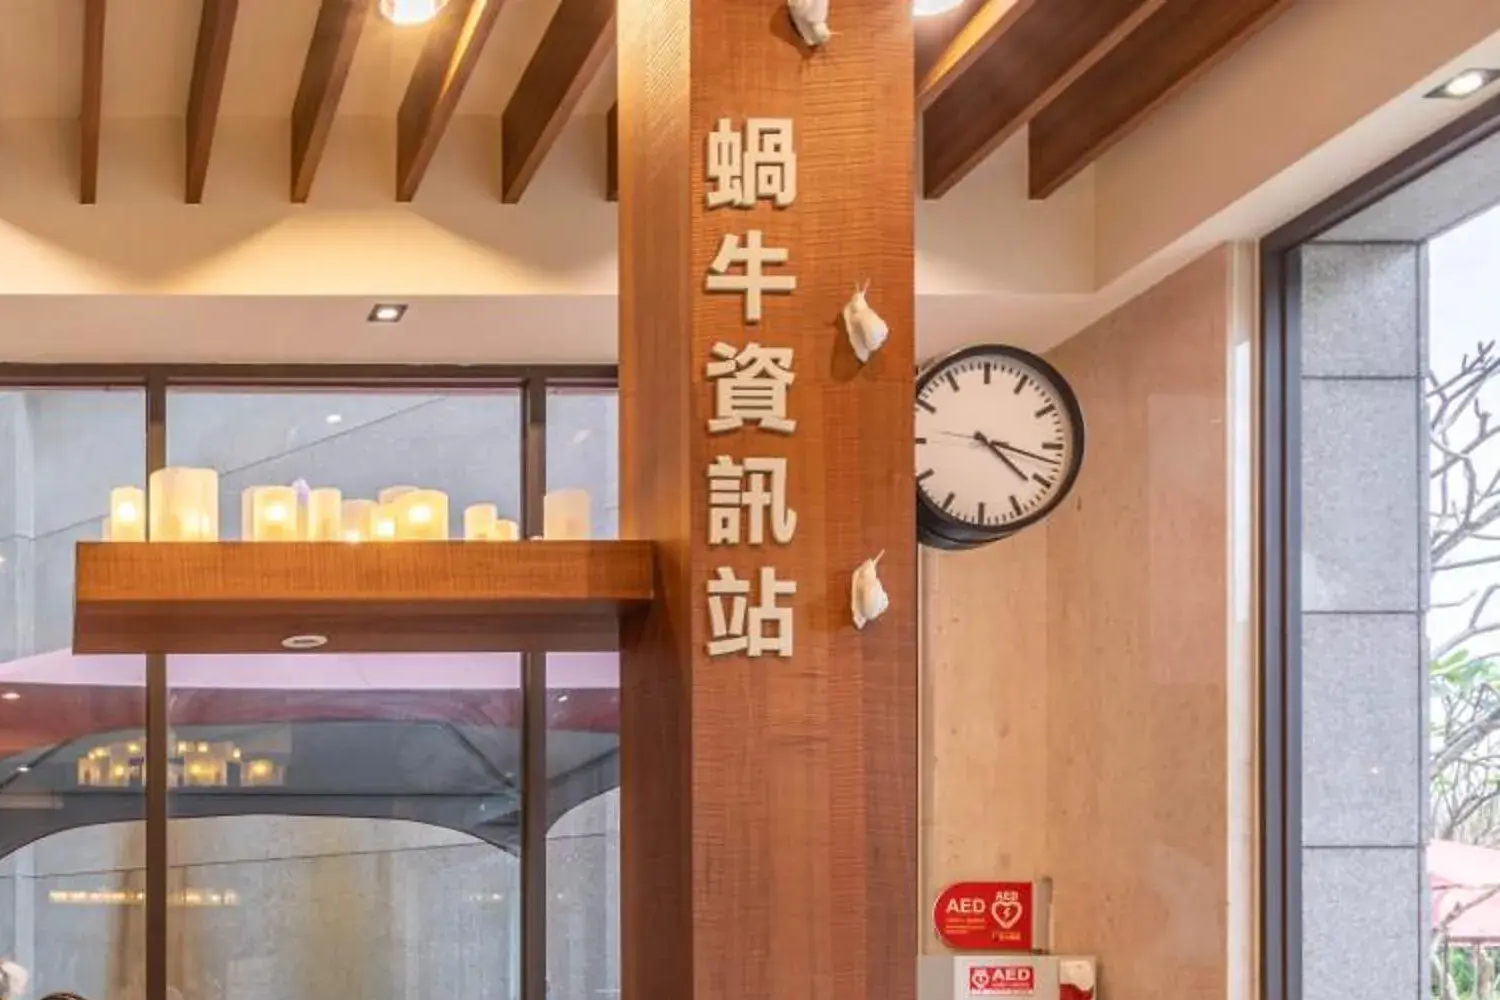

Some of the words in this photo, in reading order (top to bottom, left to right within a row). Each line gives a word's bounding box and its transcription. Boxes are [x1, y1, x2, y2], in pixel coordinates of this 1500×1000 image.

[705, 116, 798, 658] 蝸牛資訊站
[946, 897, 986, 914] AED
[991, 968, 1031, 982] AED
